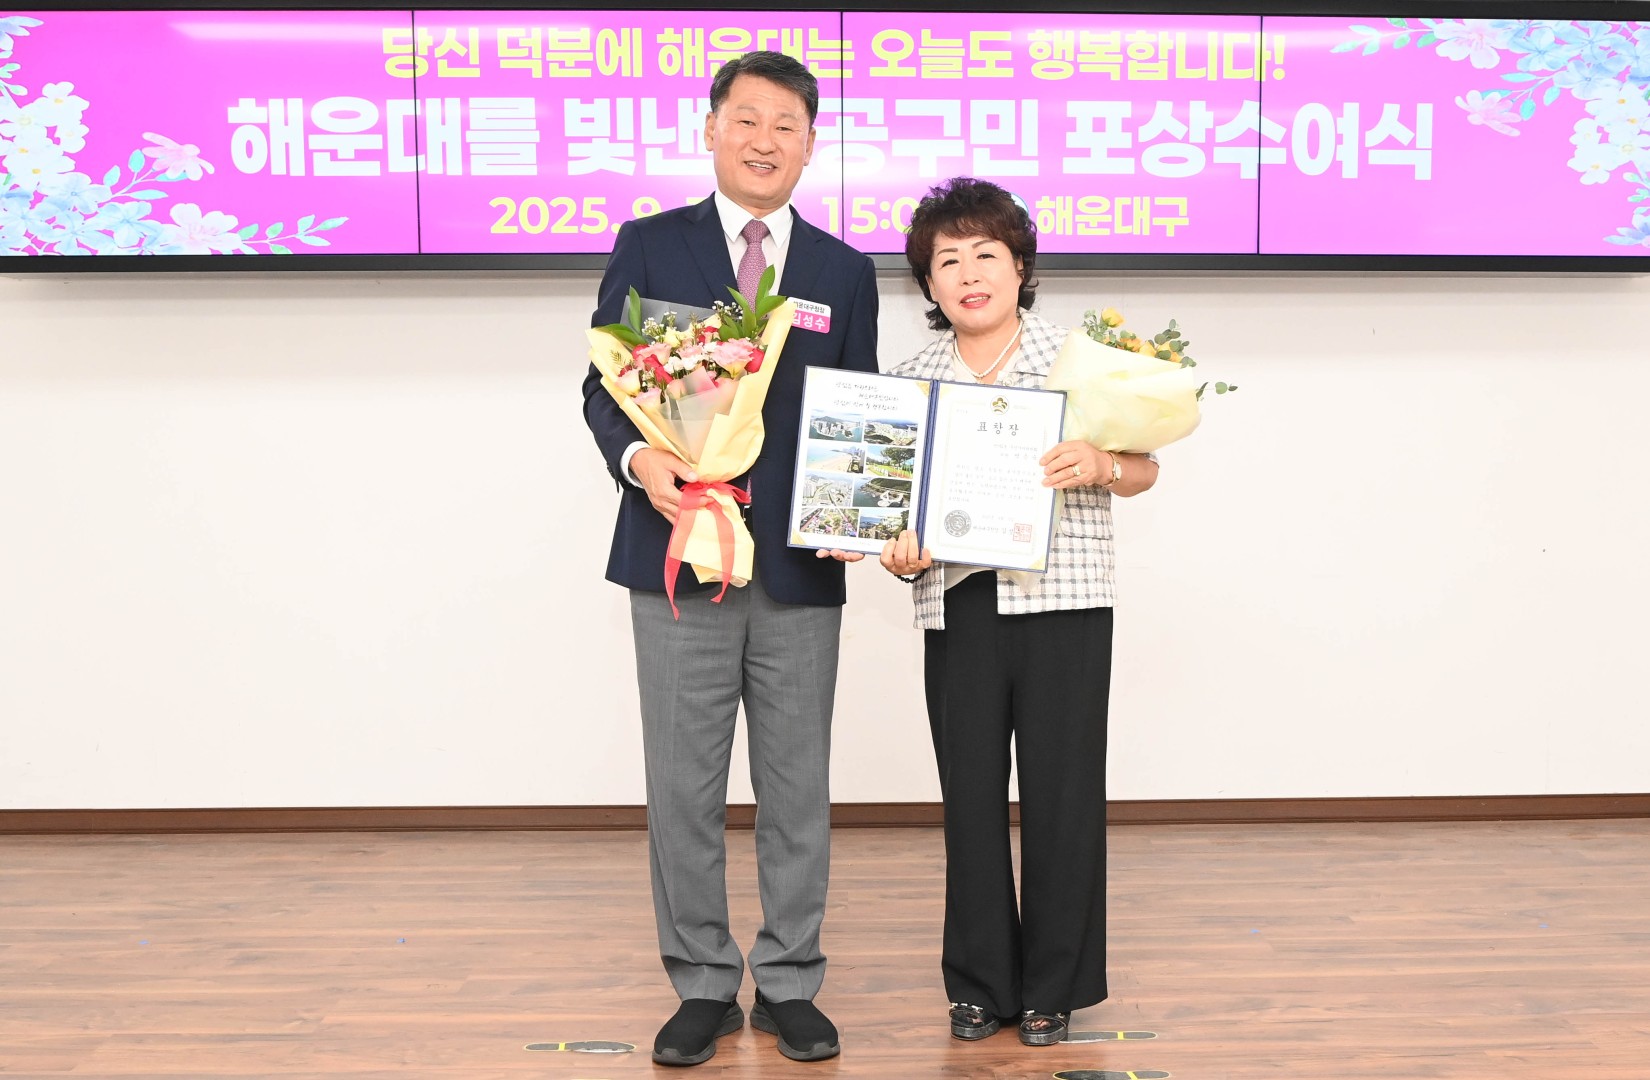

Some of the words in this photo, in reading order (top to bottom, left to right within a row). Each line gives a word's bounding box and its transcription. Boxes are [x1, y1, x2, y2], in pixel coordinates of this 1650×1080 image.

[382, 27, 482, 78] 당신
[496, 27, 643, 78] 덕분에
[869, 28, 1014, 78] 오늘도
[1029, 30, 1286, 82] 행복합니다!
[227, 96, 540, 177] 해운대를
[563, 97, 714, 177] 빛낸
[808, 97, 1039, 179] 공구민
[1062, 99, 1433, 181] 포상수여식
[822, 196, 921, 235] 15:0
[1037, 196, 1189, 236] 해운대구
